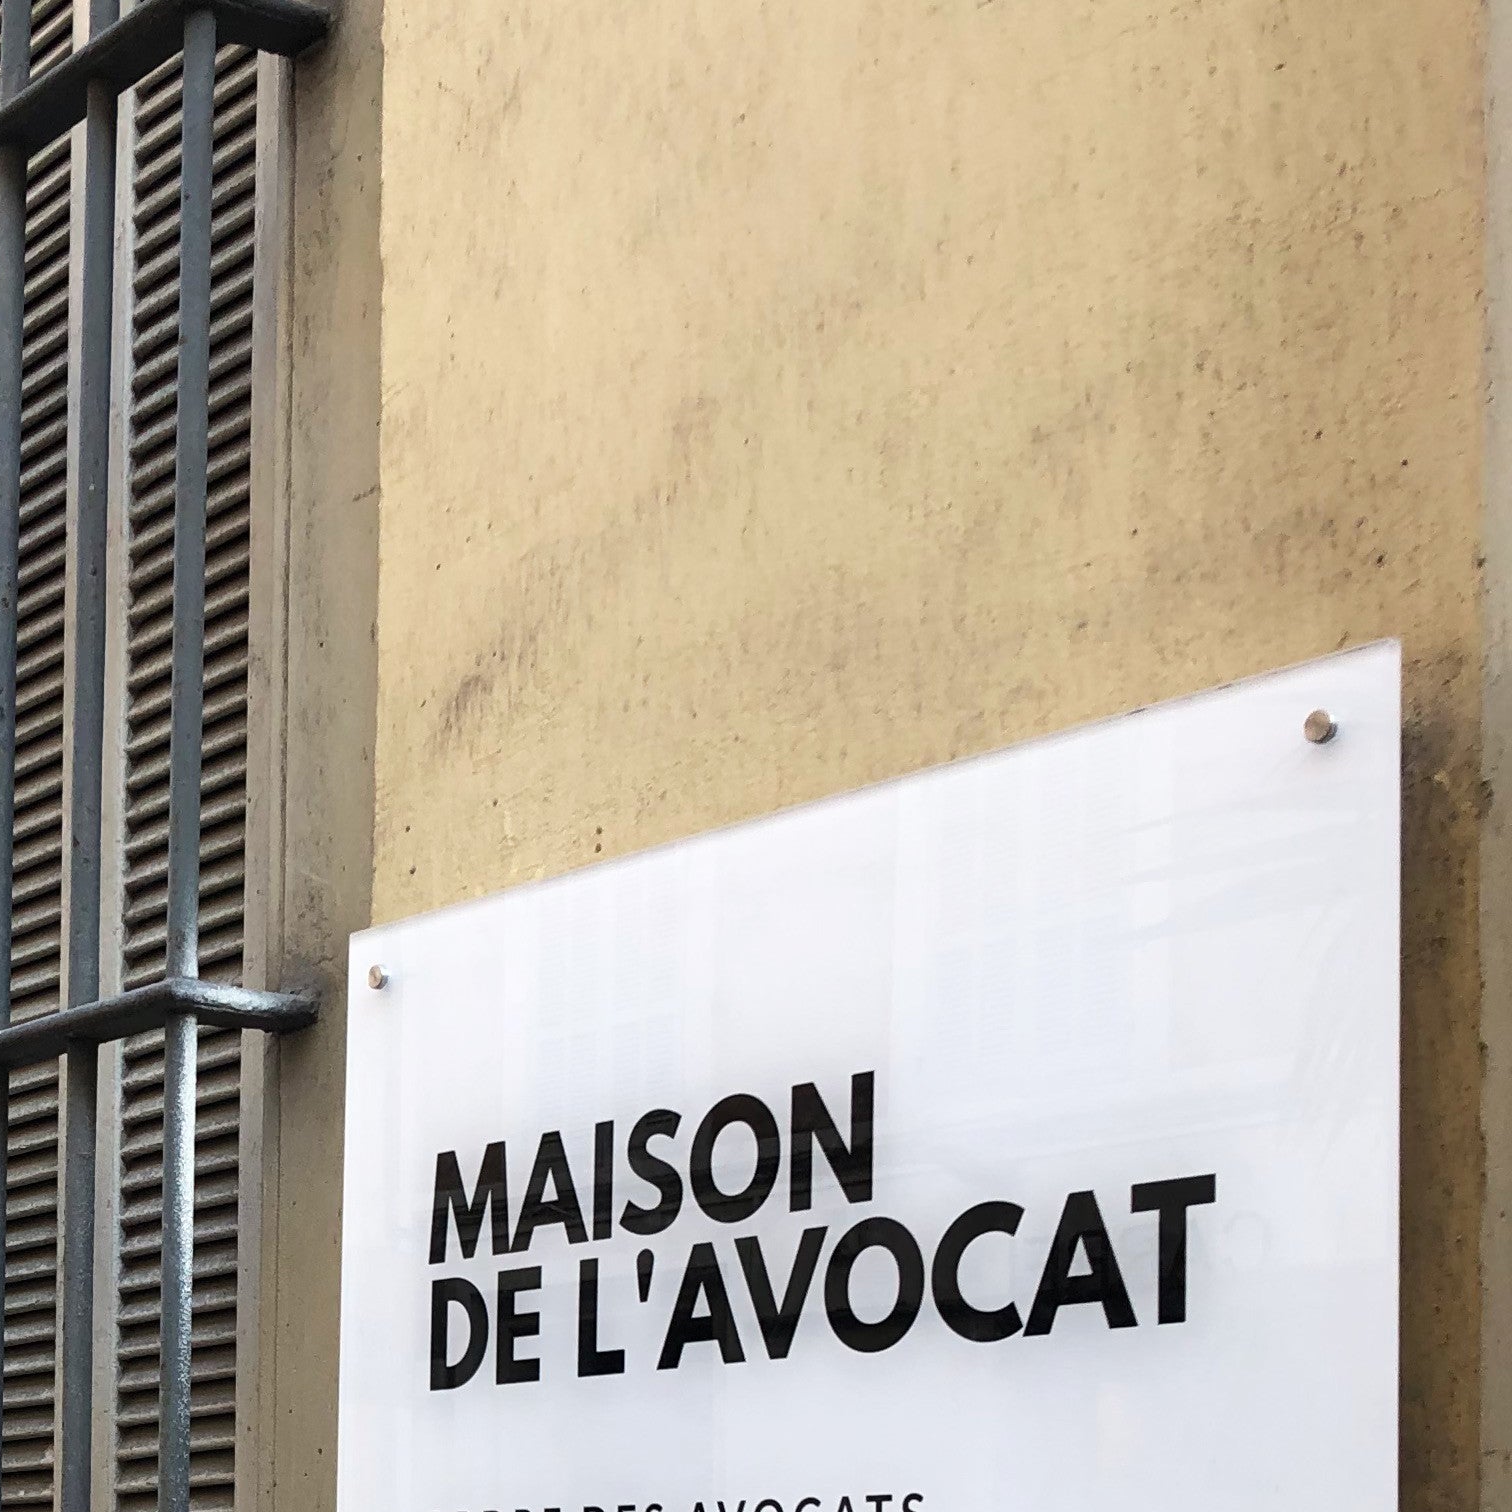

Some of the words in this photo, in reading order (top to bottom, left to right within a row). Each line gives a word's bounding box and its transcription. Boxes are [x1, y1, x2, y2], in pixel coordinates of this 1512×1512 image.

[428, 1070, 876, 1265] MAISON
[429, 1265, 544, 1391] DE
[577, 1173, 1216, 1378] L'AVOCAT
